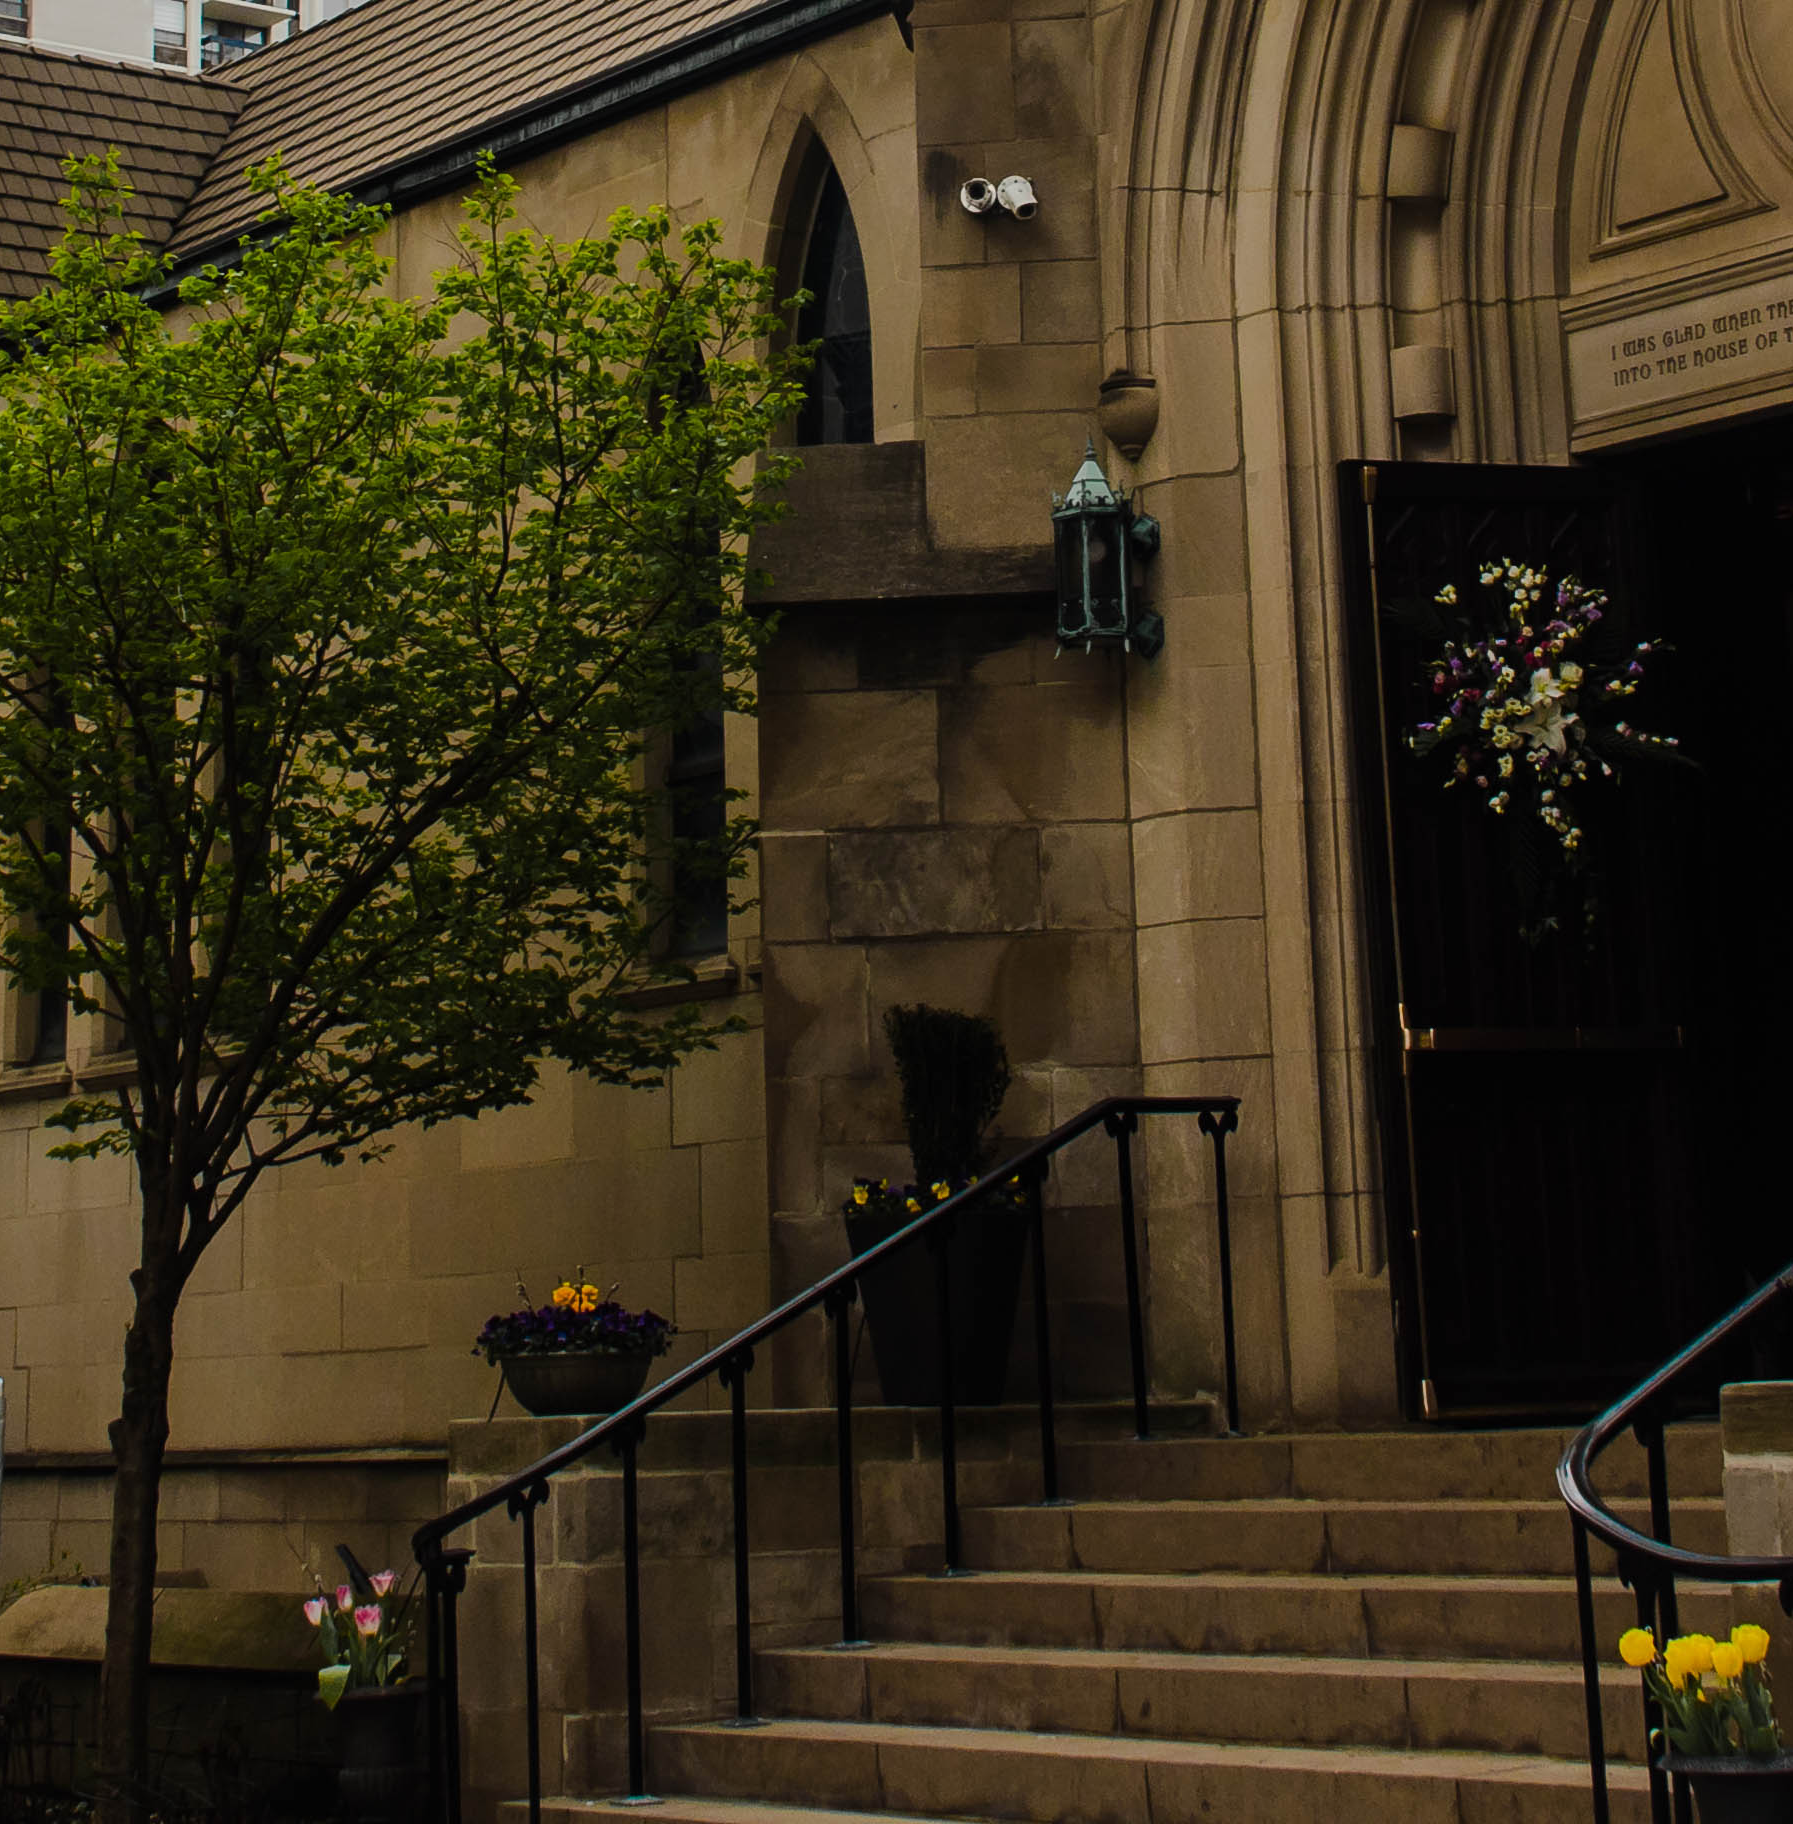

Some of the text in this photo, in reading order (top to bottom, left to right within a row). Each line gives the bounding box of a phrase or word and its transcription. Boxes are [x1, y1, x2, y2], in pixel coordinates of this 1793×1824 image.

[1611, 345, 1617, 361] I
[1623, 336, 1657, 358] WAS
[1662, 323, 1706, 347] GLAD
[1712, 308, 1762, 334] WHEN
[1614, 364, 1651, 387] INTO
[1656, 354, 1687, 375] THE
[1694, 338, 1748, 368] HOUSE
[1755, 331, 1778, 350] OF
